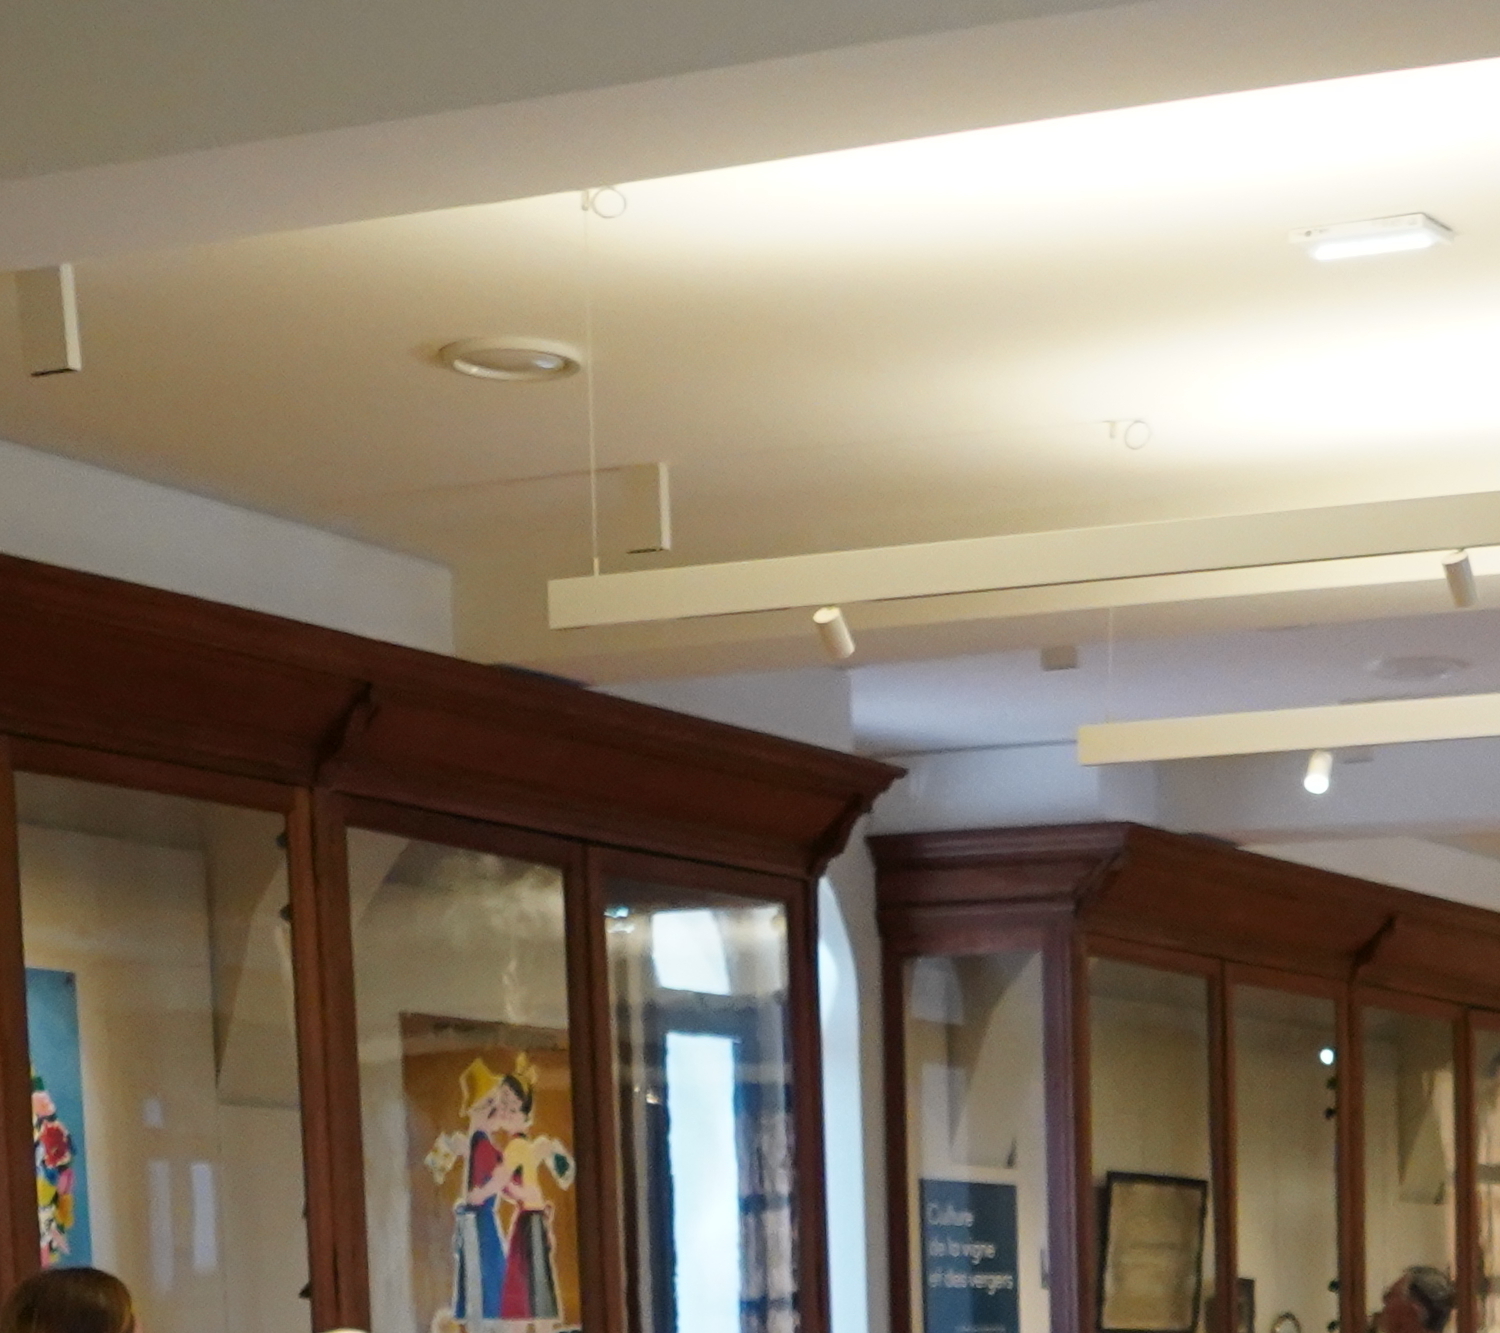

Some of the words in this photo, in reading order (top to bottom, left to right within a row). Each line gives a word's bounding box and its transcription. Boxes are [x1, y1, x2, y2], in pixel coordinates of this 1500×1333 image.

[962, 1240, 996, 1265] vigne
[943, 1269, 966, 1288] des
[968, 1274, 1014, 1296] vergers
